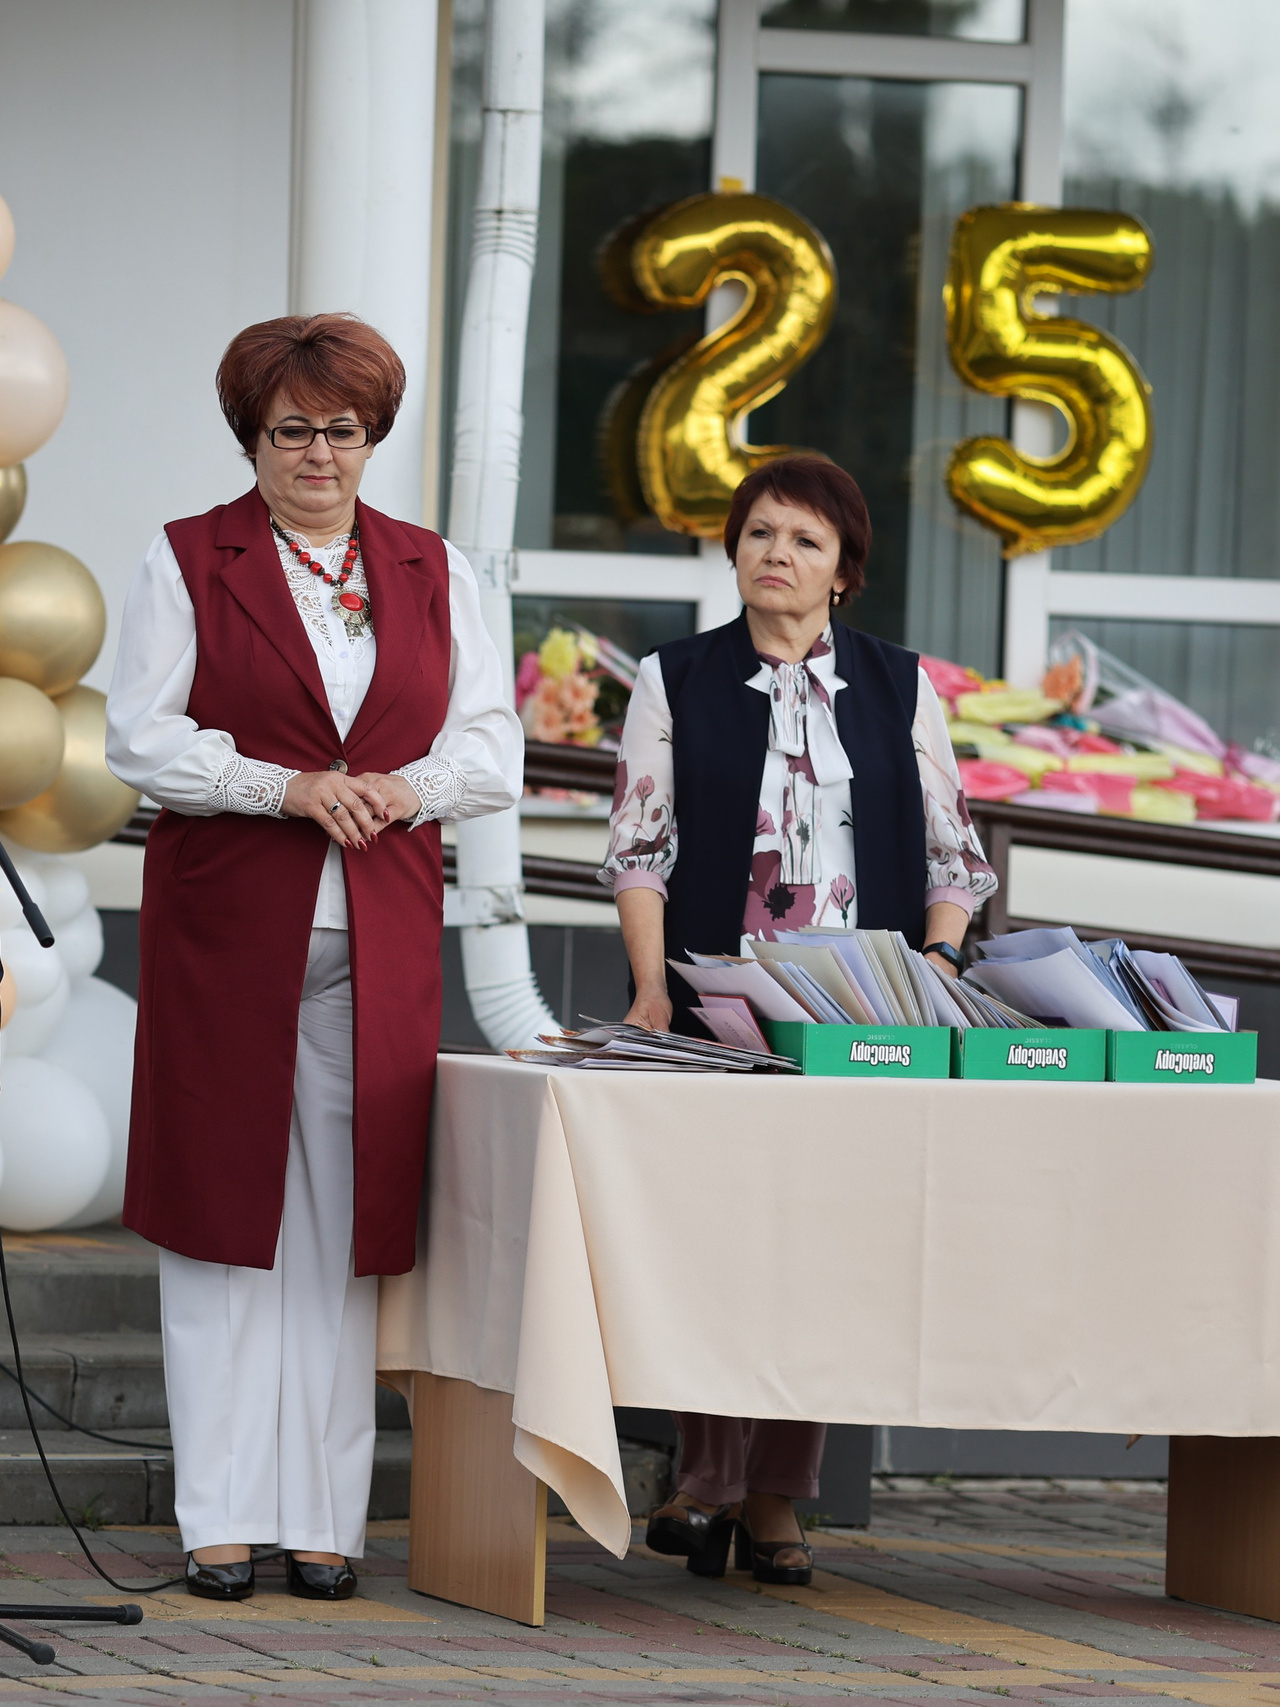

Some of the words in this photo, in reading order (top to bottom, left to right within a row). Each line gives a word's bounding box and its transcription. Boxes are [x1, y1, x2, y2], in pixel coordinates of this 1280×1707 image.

[849, 1041, 911, 1067] SvetoCopy
[1007, 1044, 1068, 1070] SvetoCopy
[1154, 1049, 1215, 1075] SvetoCopy
